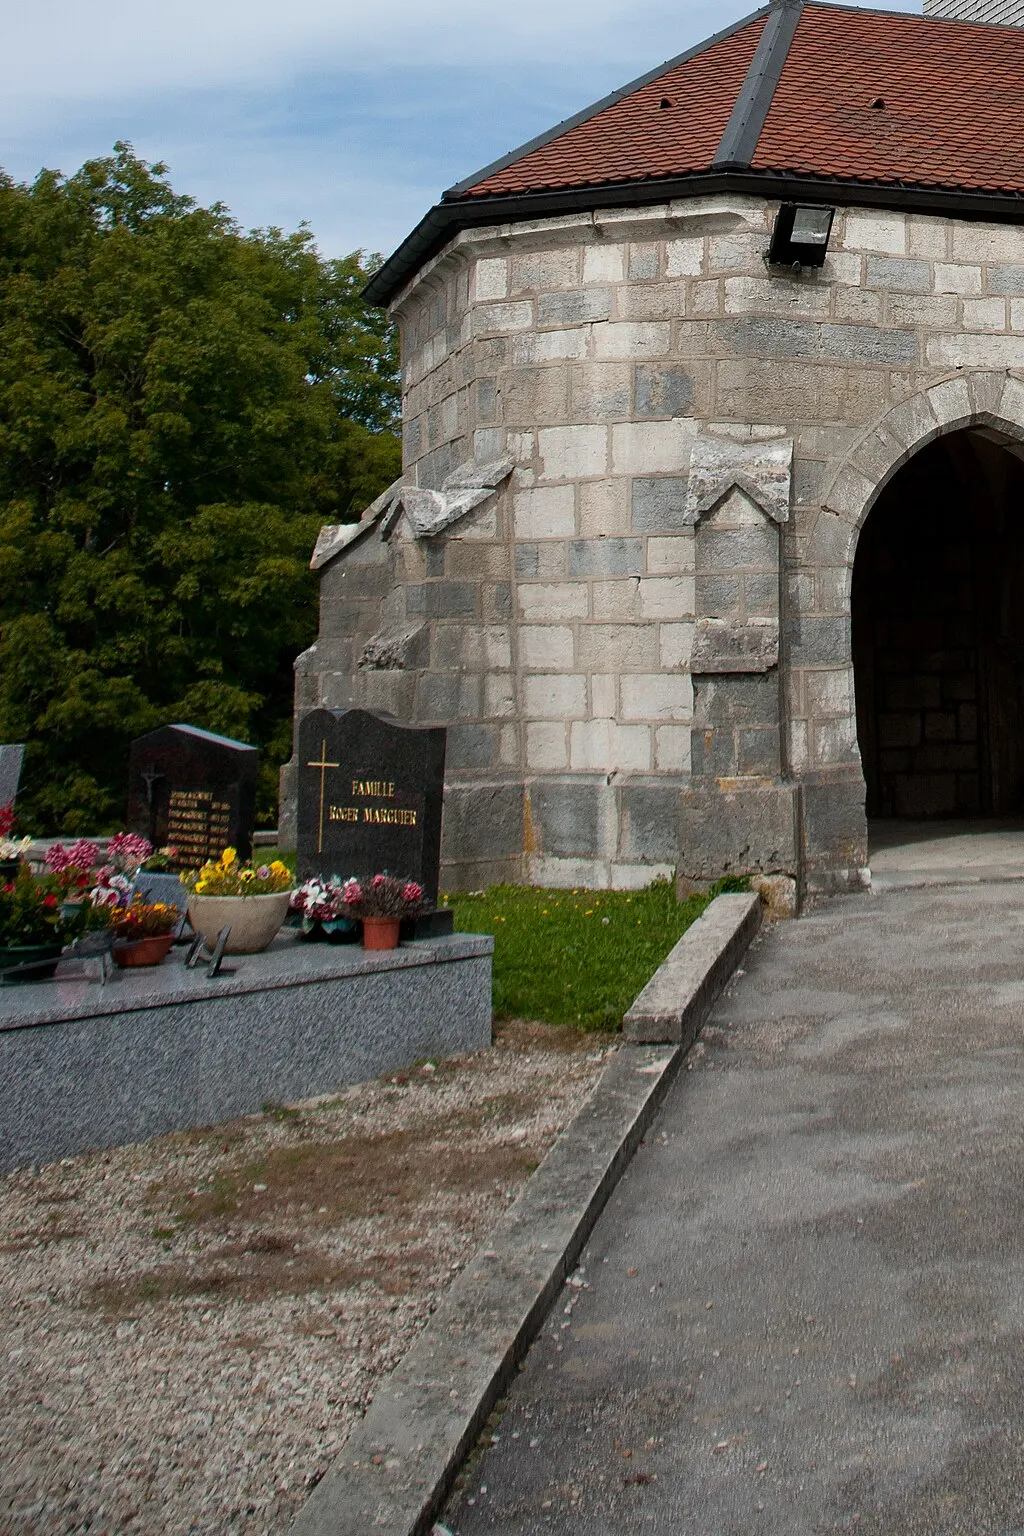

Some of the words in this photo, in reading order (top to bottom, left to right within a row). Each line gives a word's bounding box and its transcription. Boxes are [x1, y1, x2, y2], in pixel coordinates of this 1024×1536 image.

[352, 781, 395, 797] FAMILLE
[329, 806, 358, 821] ROGER
[363, 808, 417, 825] MARGUIER
